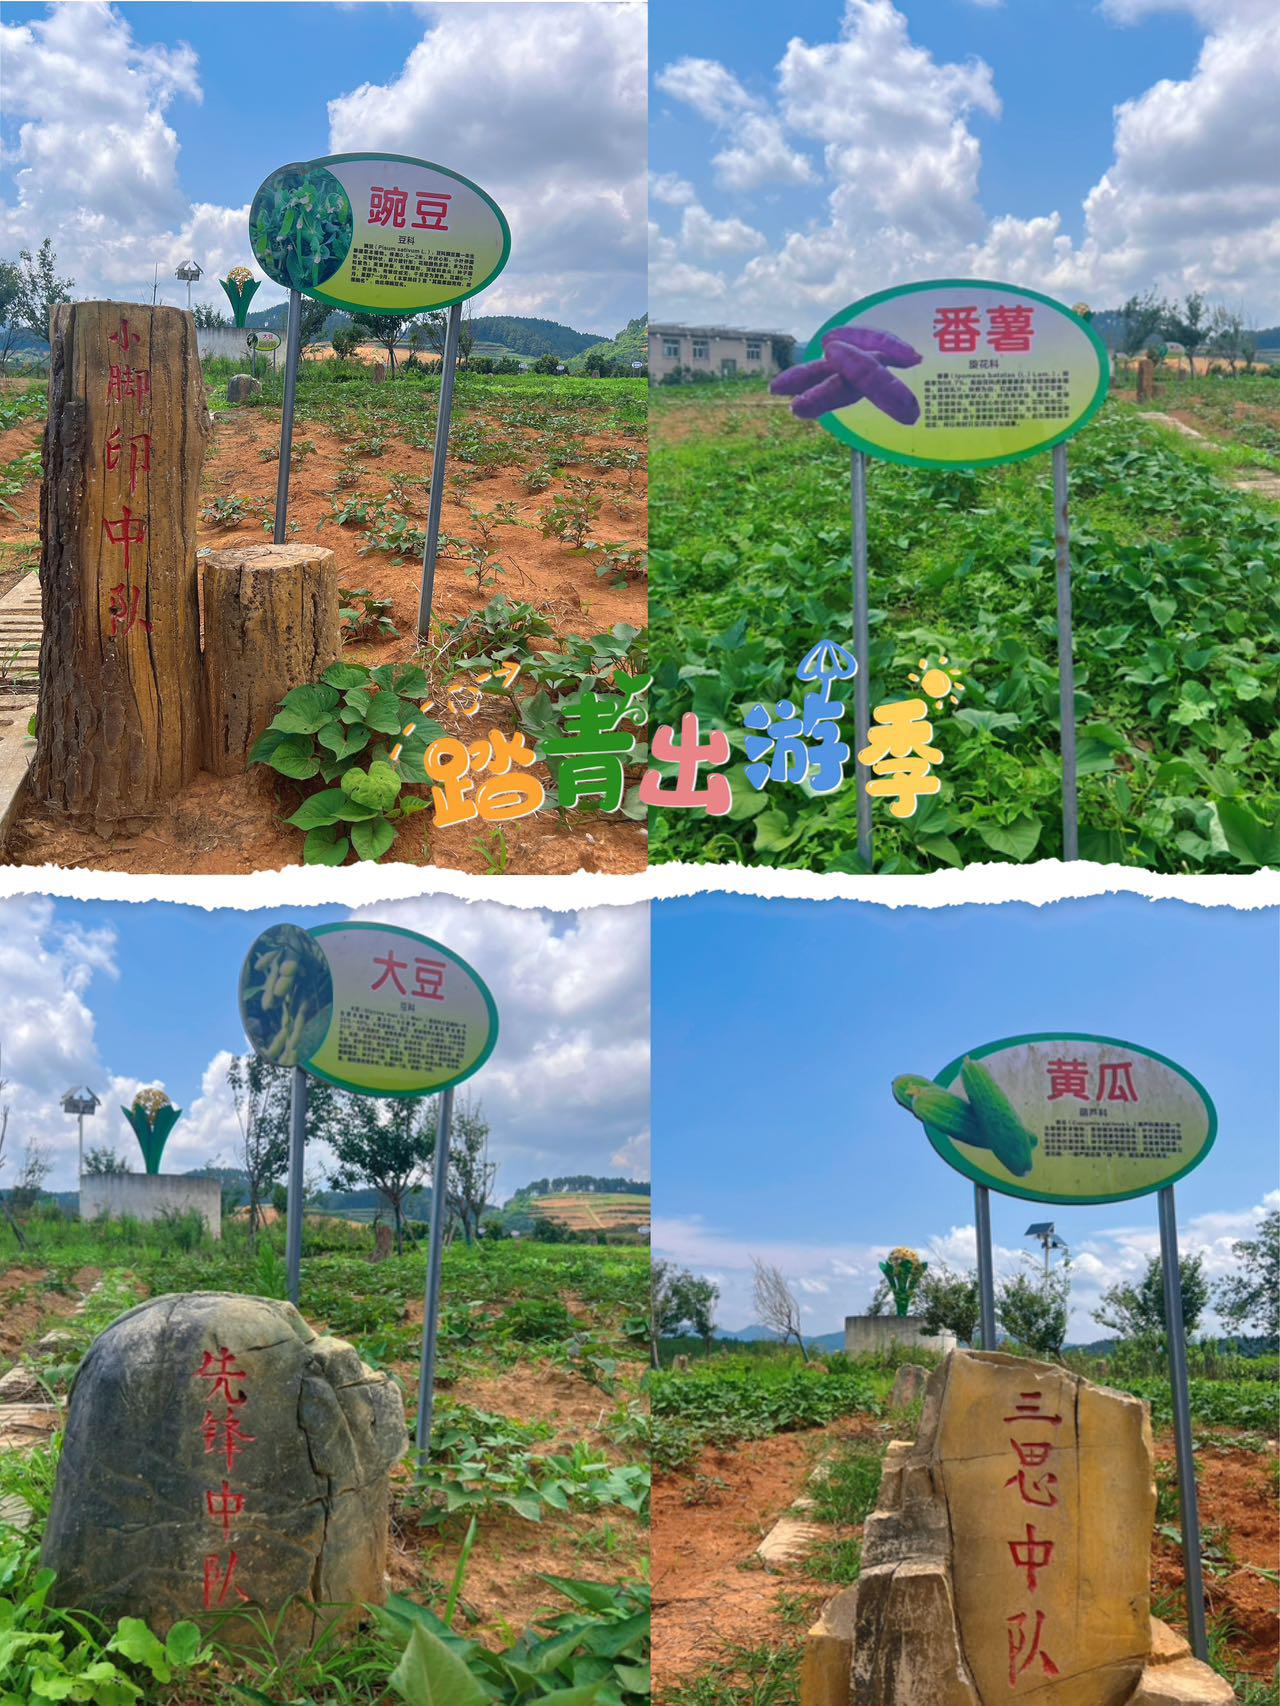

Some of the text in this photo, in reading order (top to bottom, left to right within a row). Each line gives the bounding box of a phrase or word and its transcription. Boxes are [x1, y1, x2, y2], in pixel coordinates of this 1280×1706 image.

[367, 186, 452, 231] 豌豆
[398, 235, 416, 246] 豆科
[933, 304, 1035, 354] 番薯
[101, 319, 154, 636] 小脚印中队
[371, 949, 447, 1001] 大豆
[1047, 1058, 1138, 1102] 黄瓜
[193, 1347, 257, 1609] 先锋中队
[1003, 1391, 1063, 1688] 三思中队
